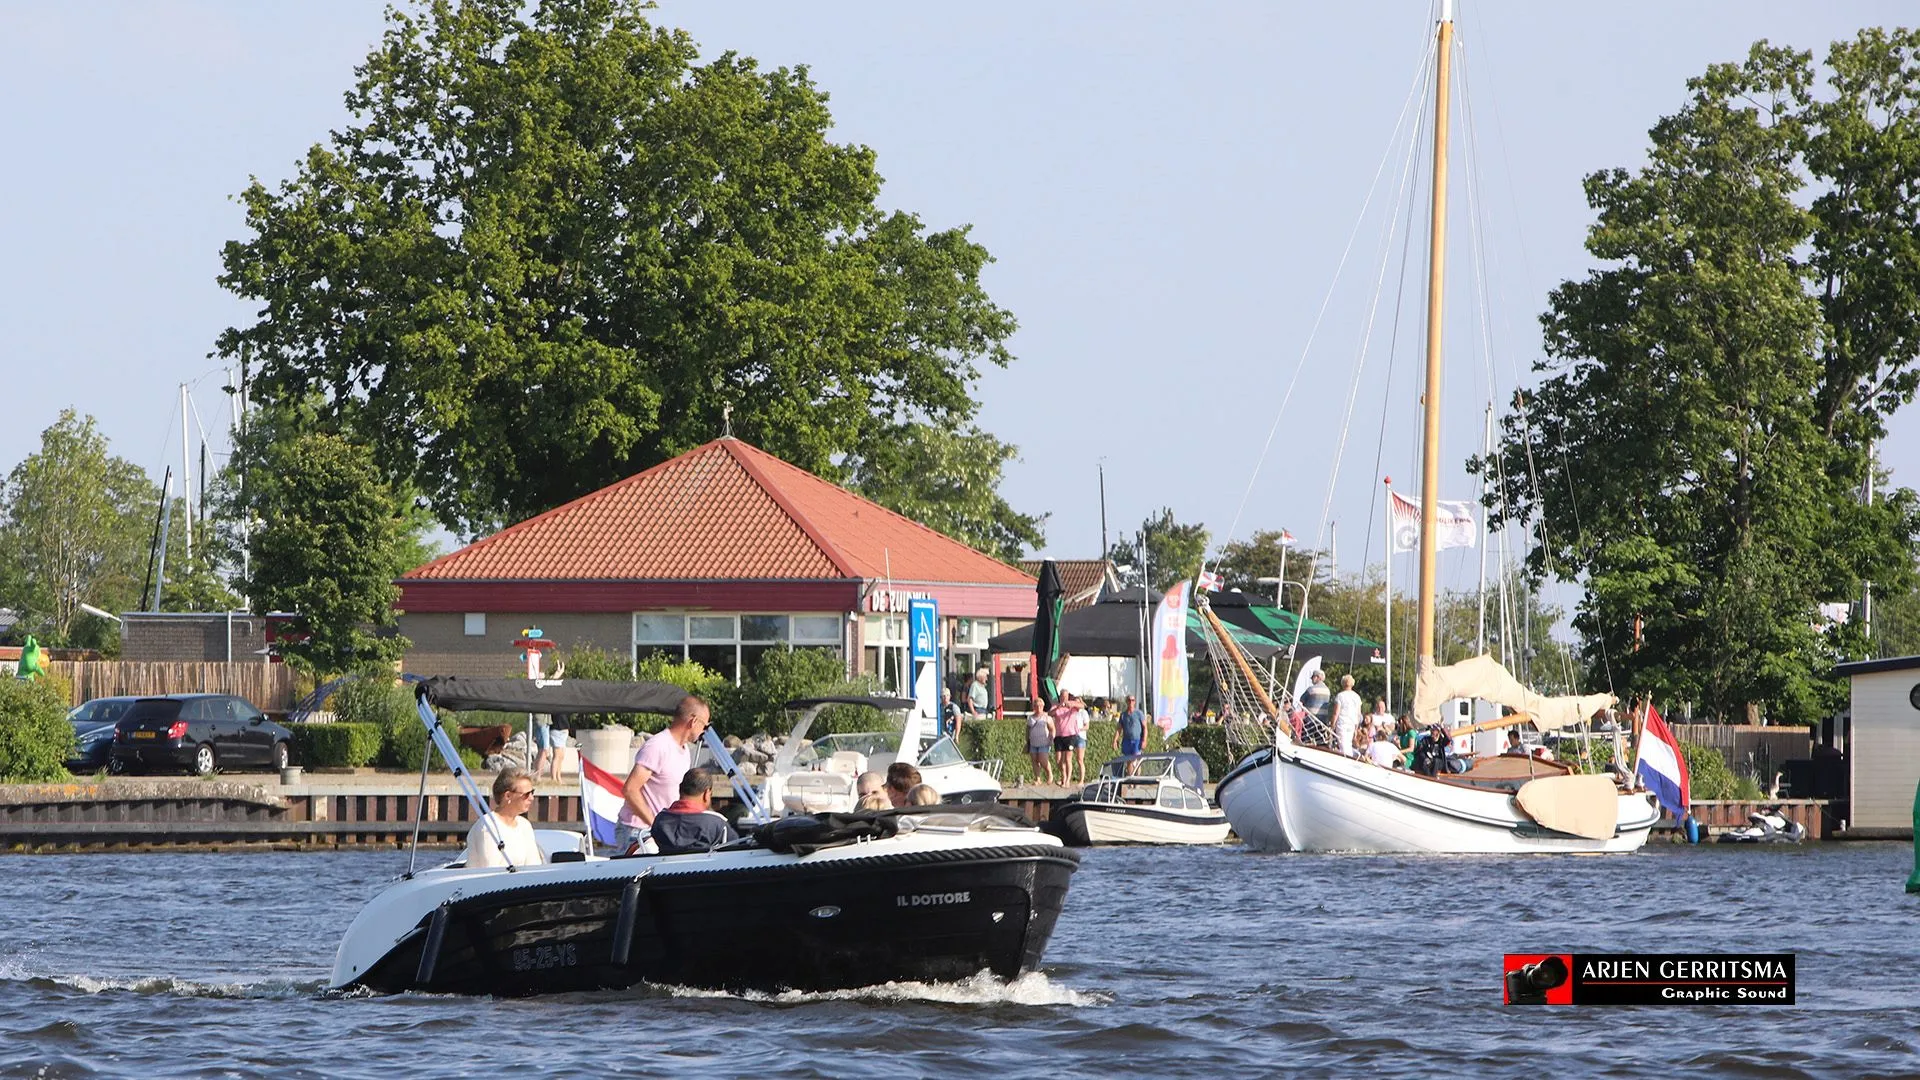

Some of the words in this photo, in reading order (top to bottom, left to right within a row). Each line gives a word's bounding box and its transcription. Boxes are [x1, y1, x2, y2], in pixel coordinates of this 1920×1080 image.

[872, 590, 886, 612] DE
[898, 896, 908, 906] IL
[912, 892, 970, 905] DOTTORE
